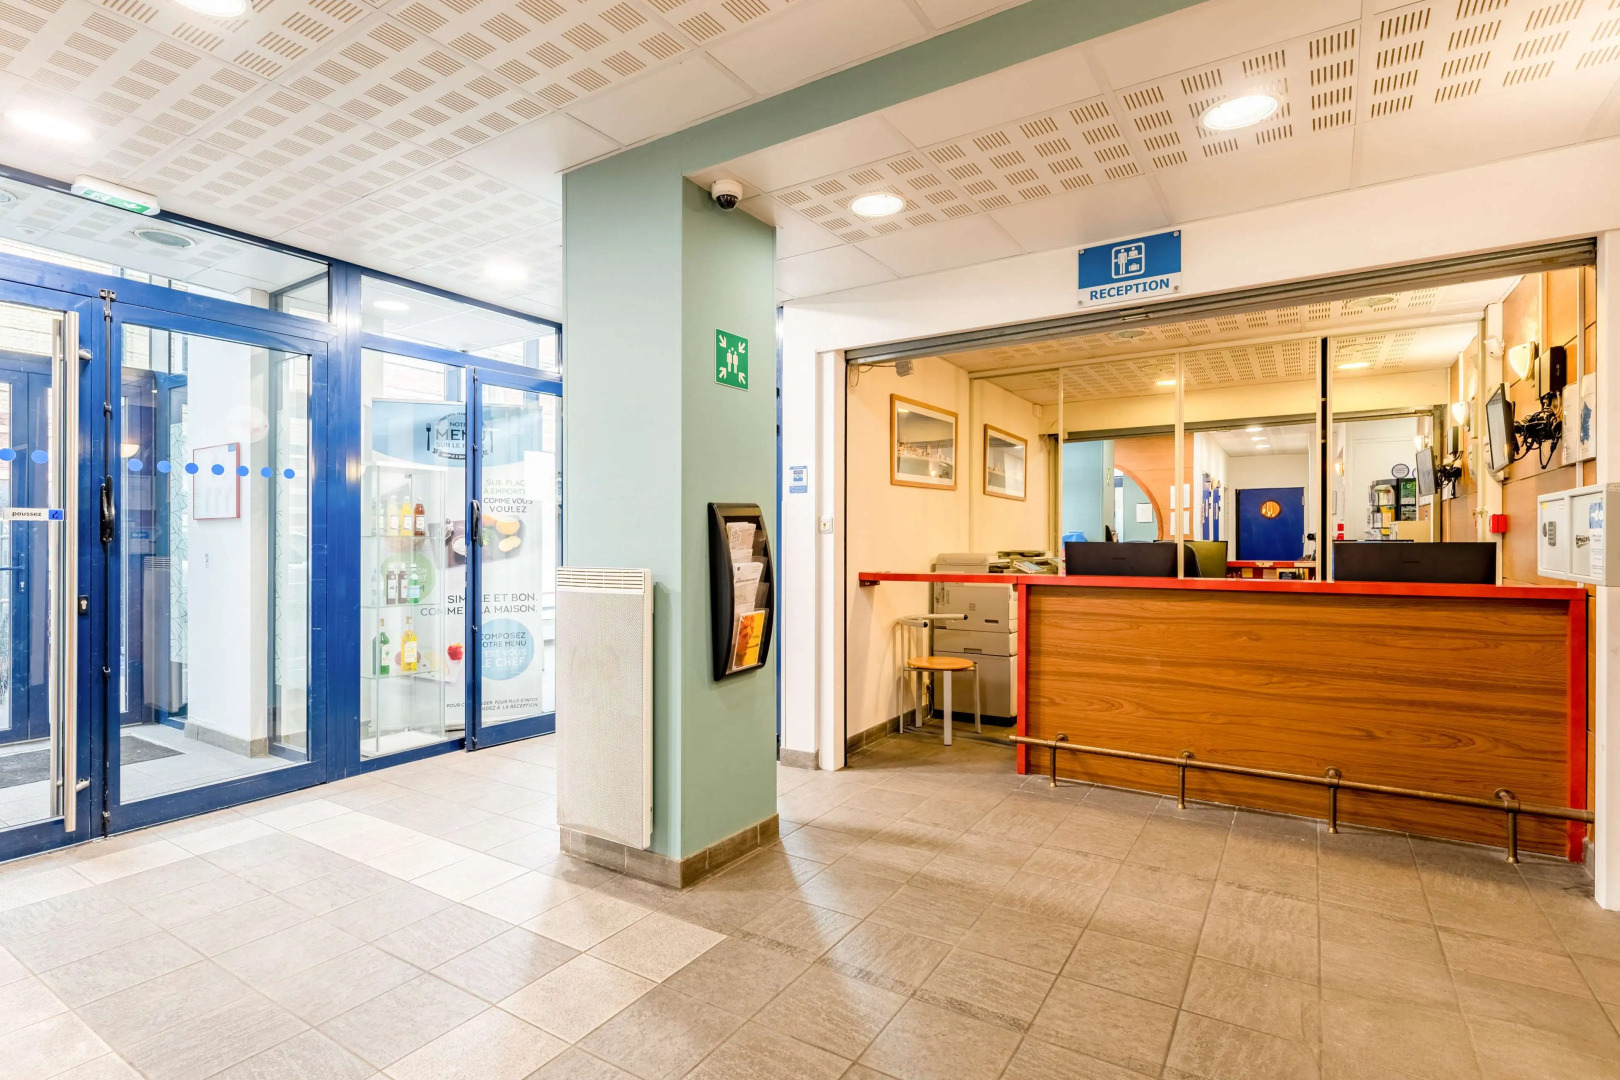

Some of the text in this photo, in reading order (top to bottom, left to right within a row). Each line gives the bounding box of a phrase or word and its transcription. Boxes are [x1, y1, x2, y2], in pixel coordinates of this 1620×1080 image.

[1090, 278, 1170, 300] RECEPTION
[494, 594, 508, 602] ET
[496, 657, 525, 666] CHEF
